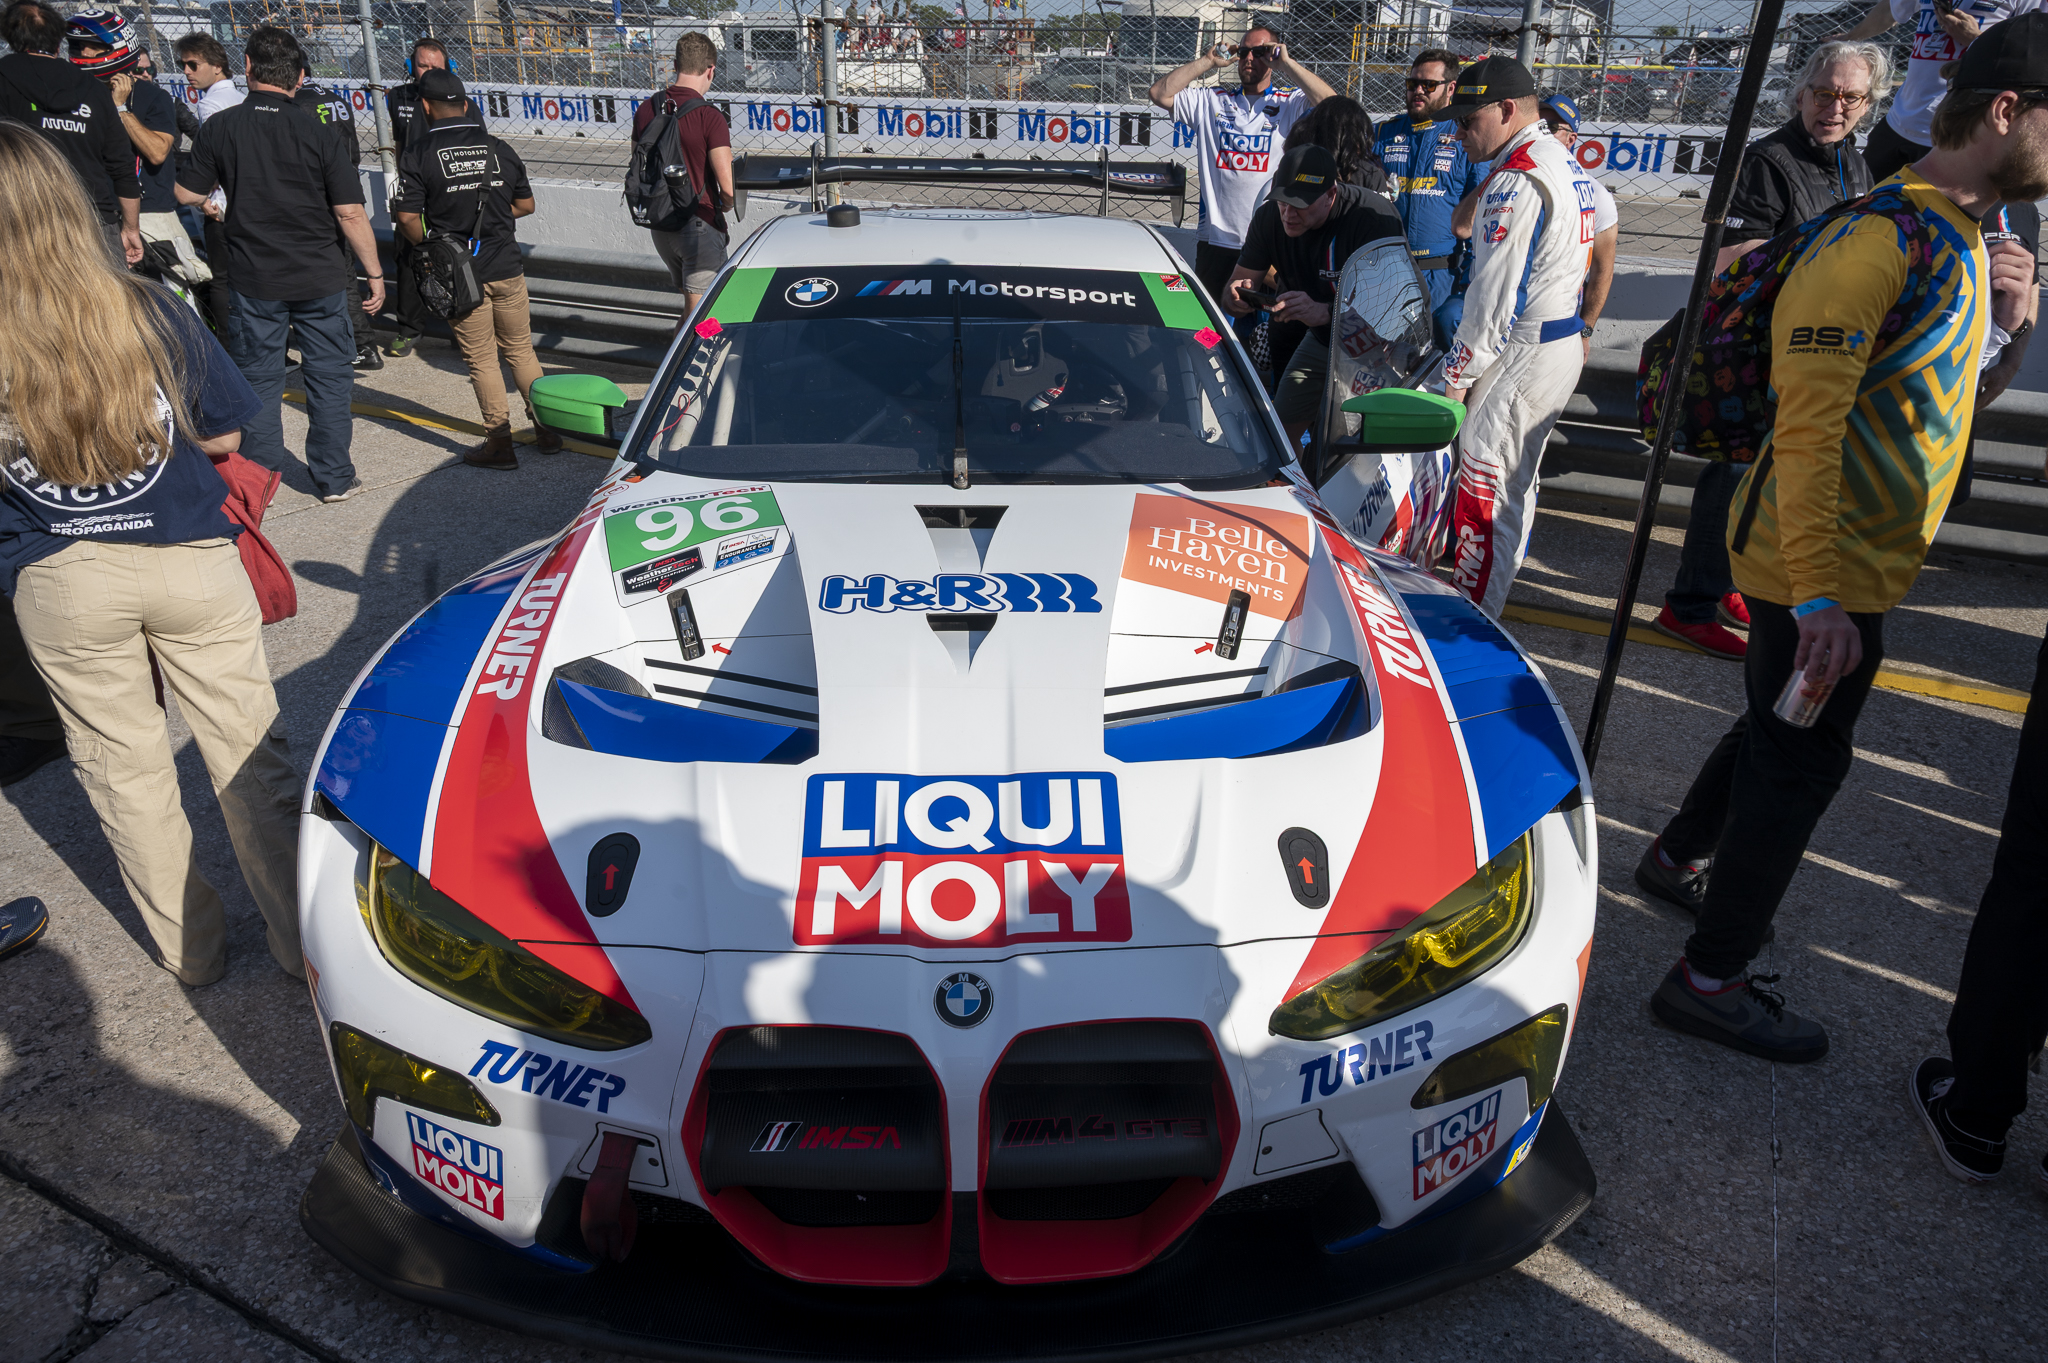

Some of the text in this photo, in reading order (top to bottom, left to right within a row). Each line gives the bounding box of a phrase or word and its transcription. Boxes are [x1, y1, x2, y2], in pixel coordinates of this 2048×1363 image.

[522, 91, 589, 122] Mobil
[747, 100, 825, 133] Mobil
[877, 104, 962, 139] Mobil
[1018, 108, 1111, 145] Mobil
[1221, 133, 1270, 153] LIQUI
[1217, 152, 1269, 171] MOLY
[1576, 131, 1668, 173] obil
[446, 185, 459, 193] US
[1410, 187, 1447, 197] motorsport
[793, 277, 833, 288] BMW
[947, 278, 1137, 307] Motorsport
[1786, 347, 1856, 357] COMPETITION
[610, 486, 767, 514] WeatherTech
[1359, 462, 1392, 536] TURNER
[50, 518, 154, 536] PROPAGANDA
[635, 496, 760, 552] 96
[1186, 517, 1289, 559] Belle
[654, 557, 676, 568] IMSA
[719, 544, 758, 560] ENDURANCE
[1147, 526, 1289, 585] Haven
[626, 556, 699, 585] WeatherTech
[1148, 555, 1284, 602] INVESTMENTS
[818, 573, 1007, 615] H&R
[476, 572, 568, 701] TURNER
[820, 778, 1106, 853] LIQUI
[810, 859, 1120, 941] MOLY
[940, 973, 988, 991] BMW
[468, 1039, 627, 1114] TURNER
[1298, 1019, 1434, 1105] TURNER
[797, 1126, 903, 1150] IMSA
[1124, 1117, 1208, 1140] GT3
[1416, 1093, 1499, 1157] LIQUI
[410, 1115, 498, 1181] LIQUI
[1417, 1122, 1496, 1197] MOLY
[416, 1147, 502, 1215] MOLY
